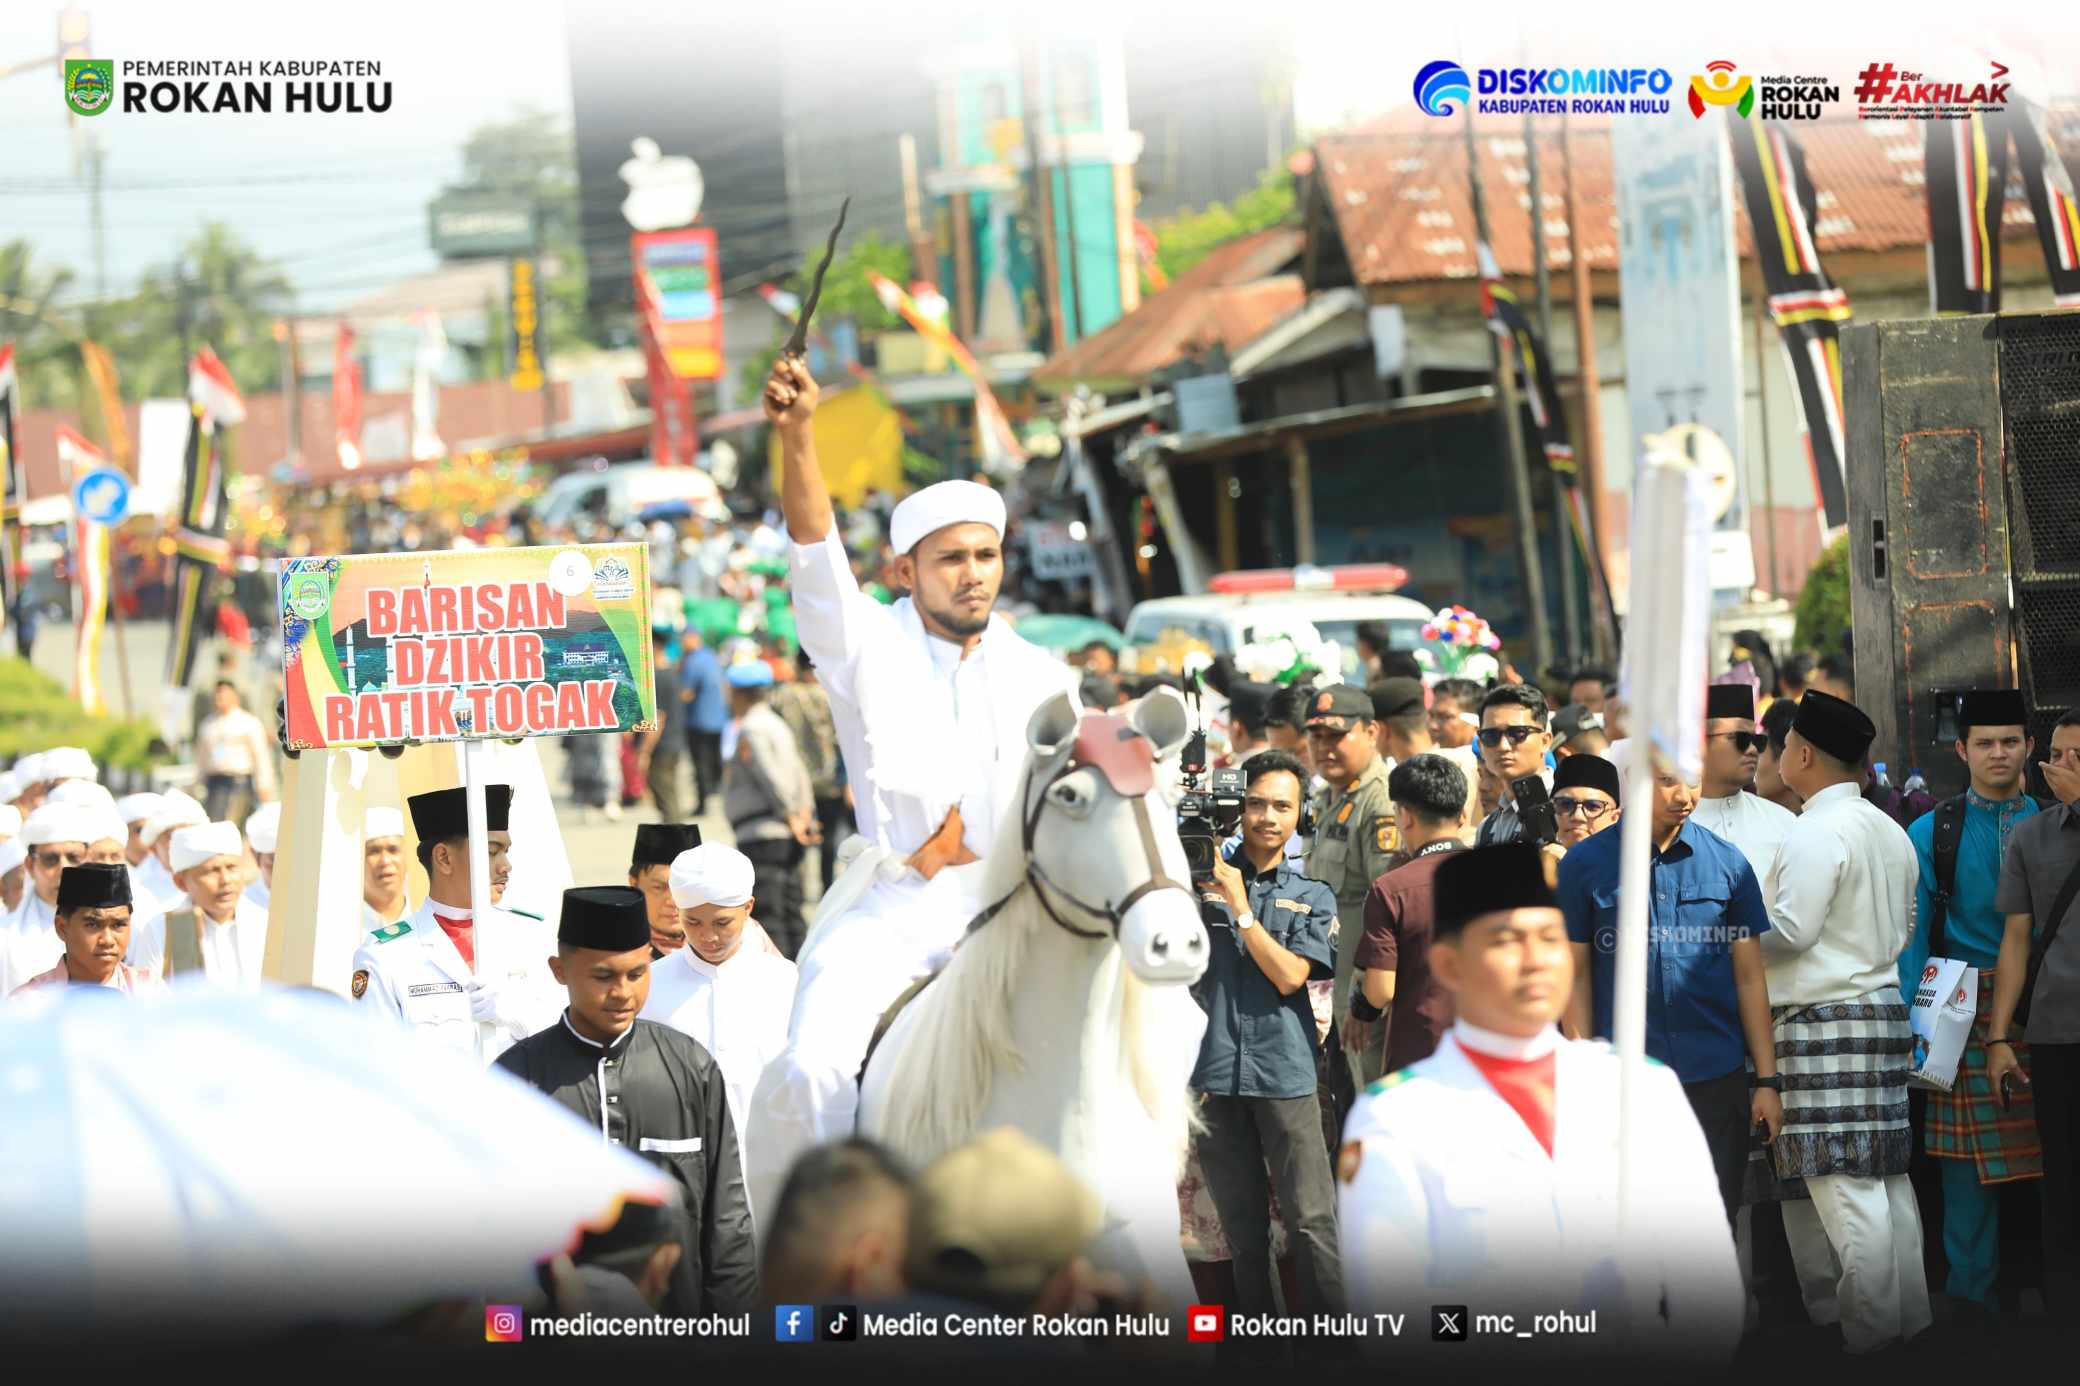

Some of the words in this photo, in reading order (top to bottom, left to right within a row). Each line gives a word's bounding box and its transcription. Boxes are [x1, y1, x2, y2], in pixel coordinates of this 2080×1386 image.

[566, 564, 575, 577] 6
[368, 582, 566, 637] BARISAN
[395, 634, 544, 687] DZIKIR
[325, 686, 460, 742] RATIK
[464, 680, 619, 733] TOGAK
[1420, 841, 1453, 857] SONY
